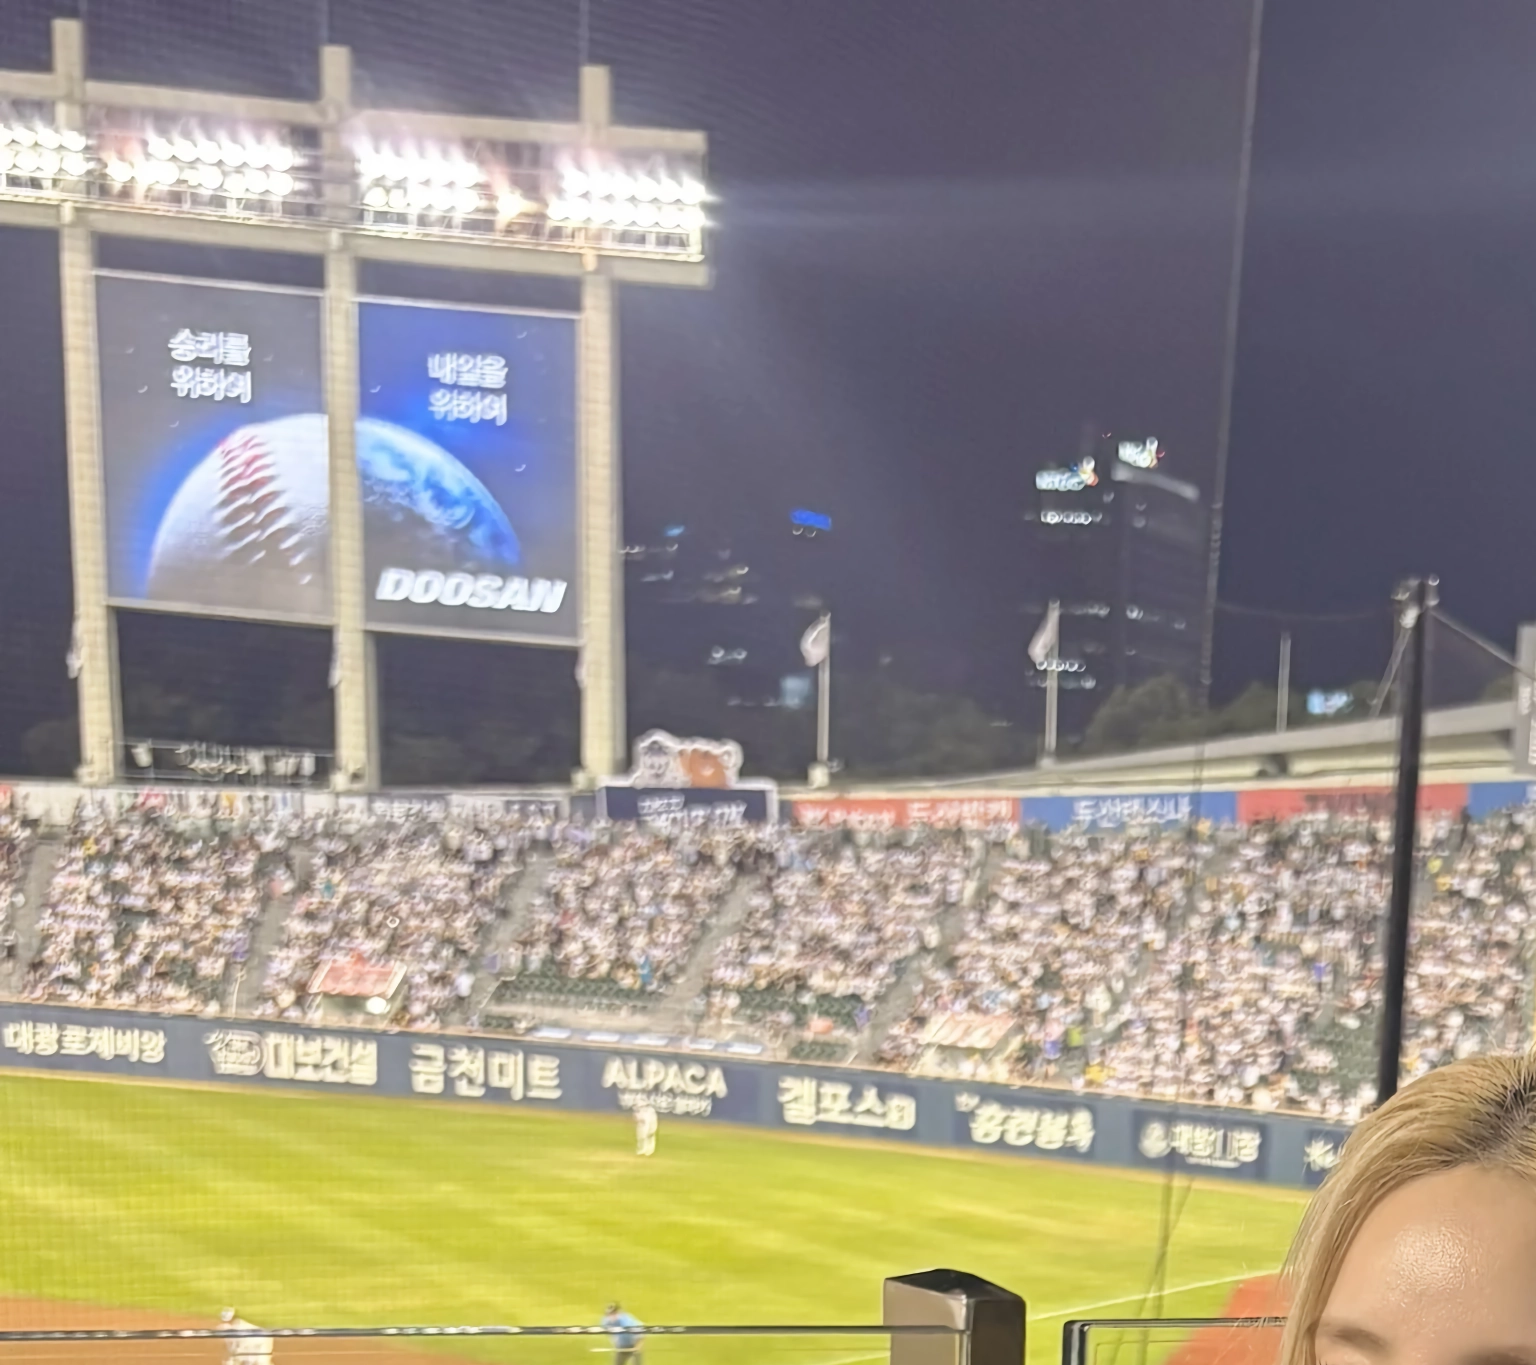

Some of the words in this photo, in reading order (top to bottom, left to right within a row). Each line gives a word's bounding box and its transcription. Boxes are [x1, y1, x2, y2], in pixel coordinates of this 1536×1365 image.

[168, 328, 252, 366] 승리를
[170, 366, 252, 403] 위하여
[427, 353, 509, 389] 내일을
[427, 388, 509, 427] 위하여
[375, 567, 568, 614] DOOSAN
[3, 1020, 167, 1063] 대광로제비앙
[263, 1032, 378, 1086] 대보건설
[409, 1042, 562, 1101] 금천미트
[602, 1056, 728, 1099] ALPACA
